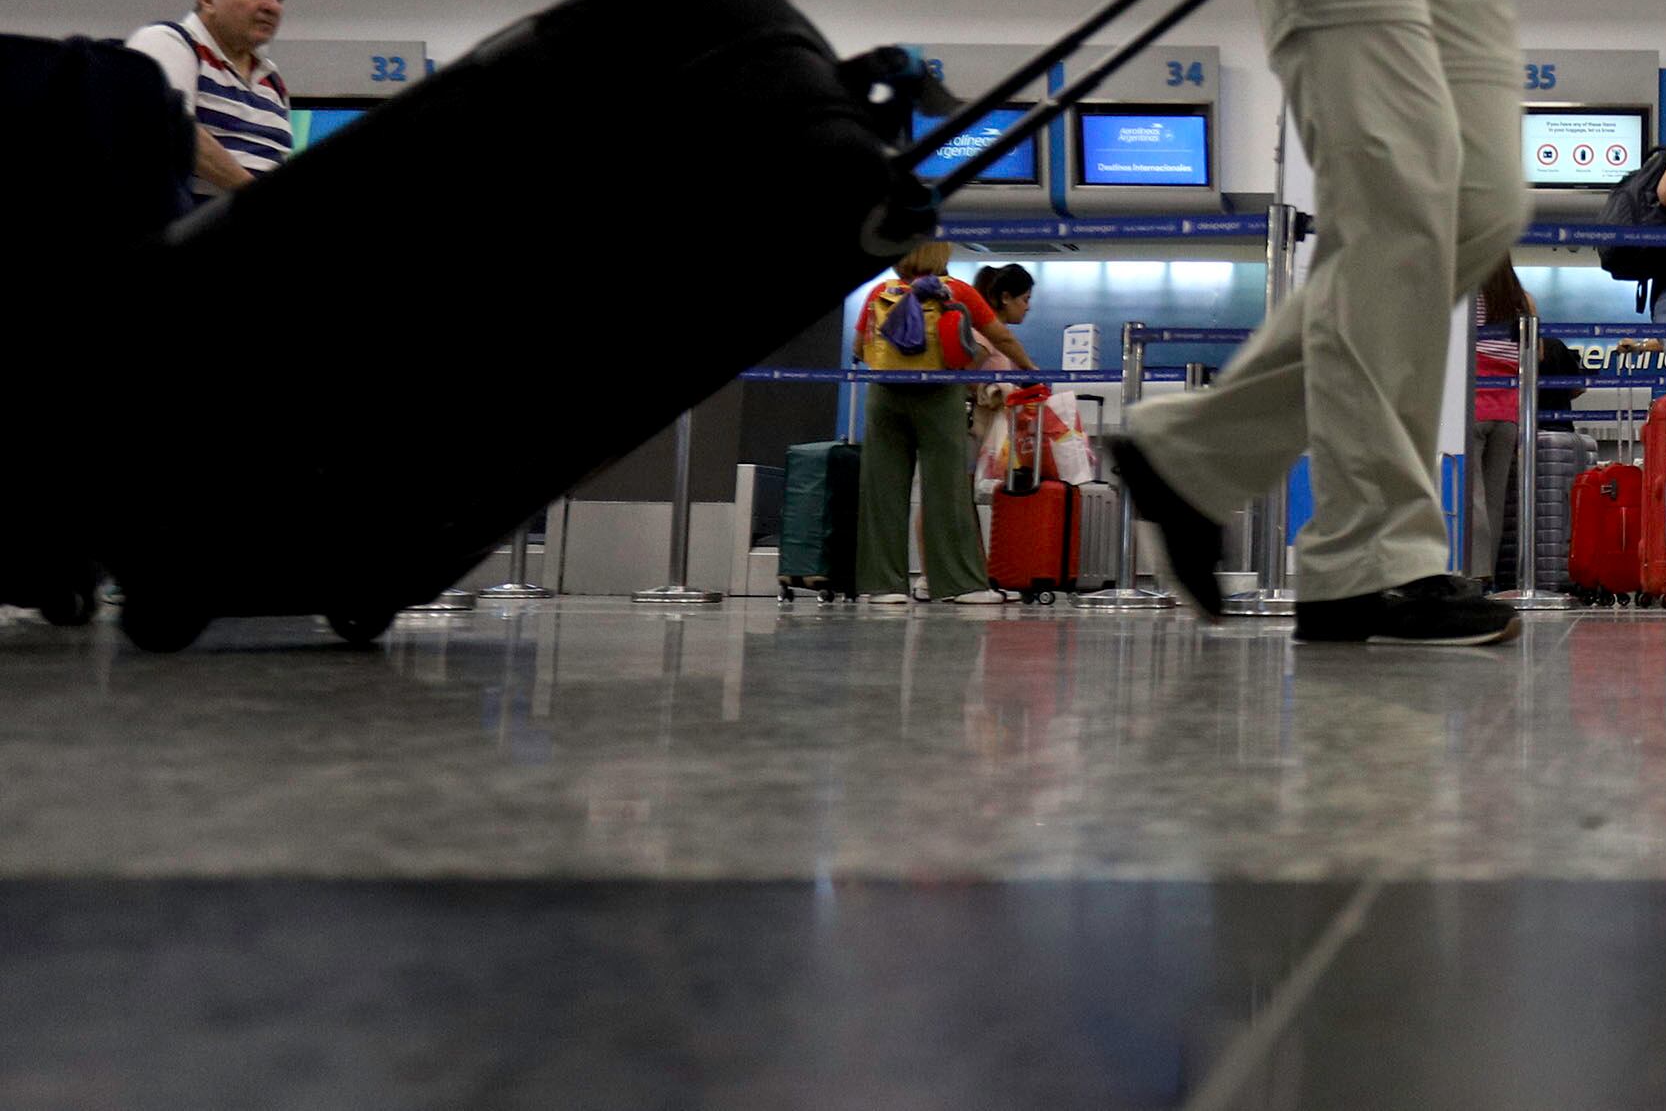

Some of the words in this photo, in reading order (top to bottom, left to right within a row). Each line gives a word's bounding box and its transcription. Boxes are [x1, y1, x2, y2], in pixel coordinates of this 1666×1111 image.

[371, 56, 407, 82] 32
[1167, 60, 1204, 87] 34
[1524, 64, 1556, 90] 35
[1097, 163, 1131, 172] Destinos
[1133, 163, 1193, 172] Internacionales
